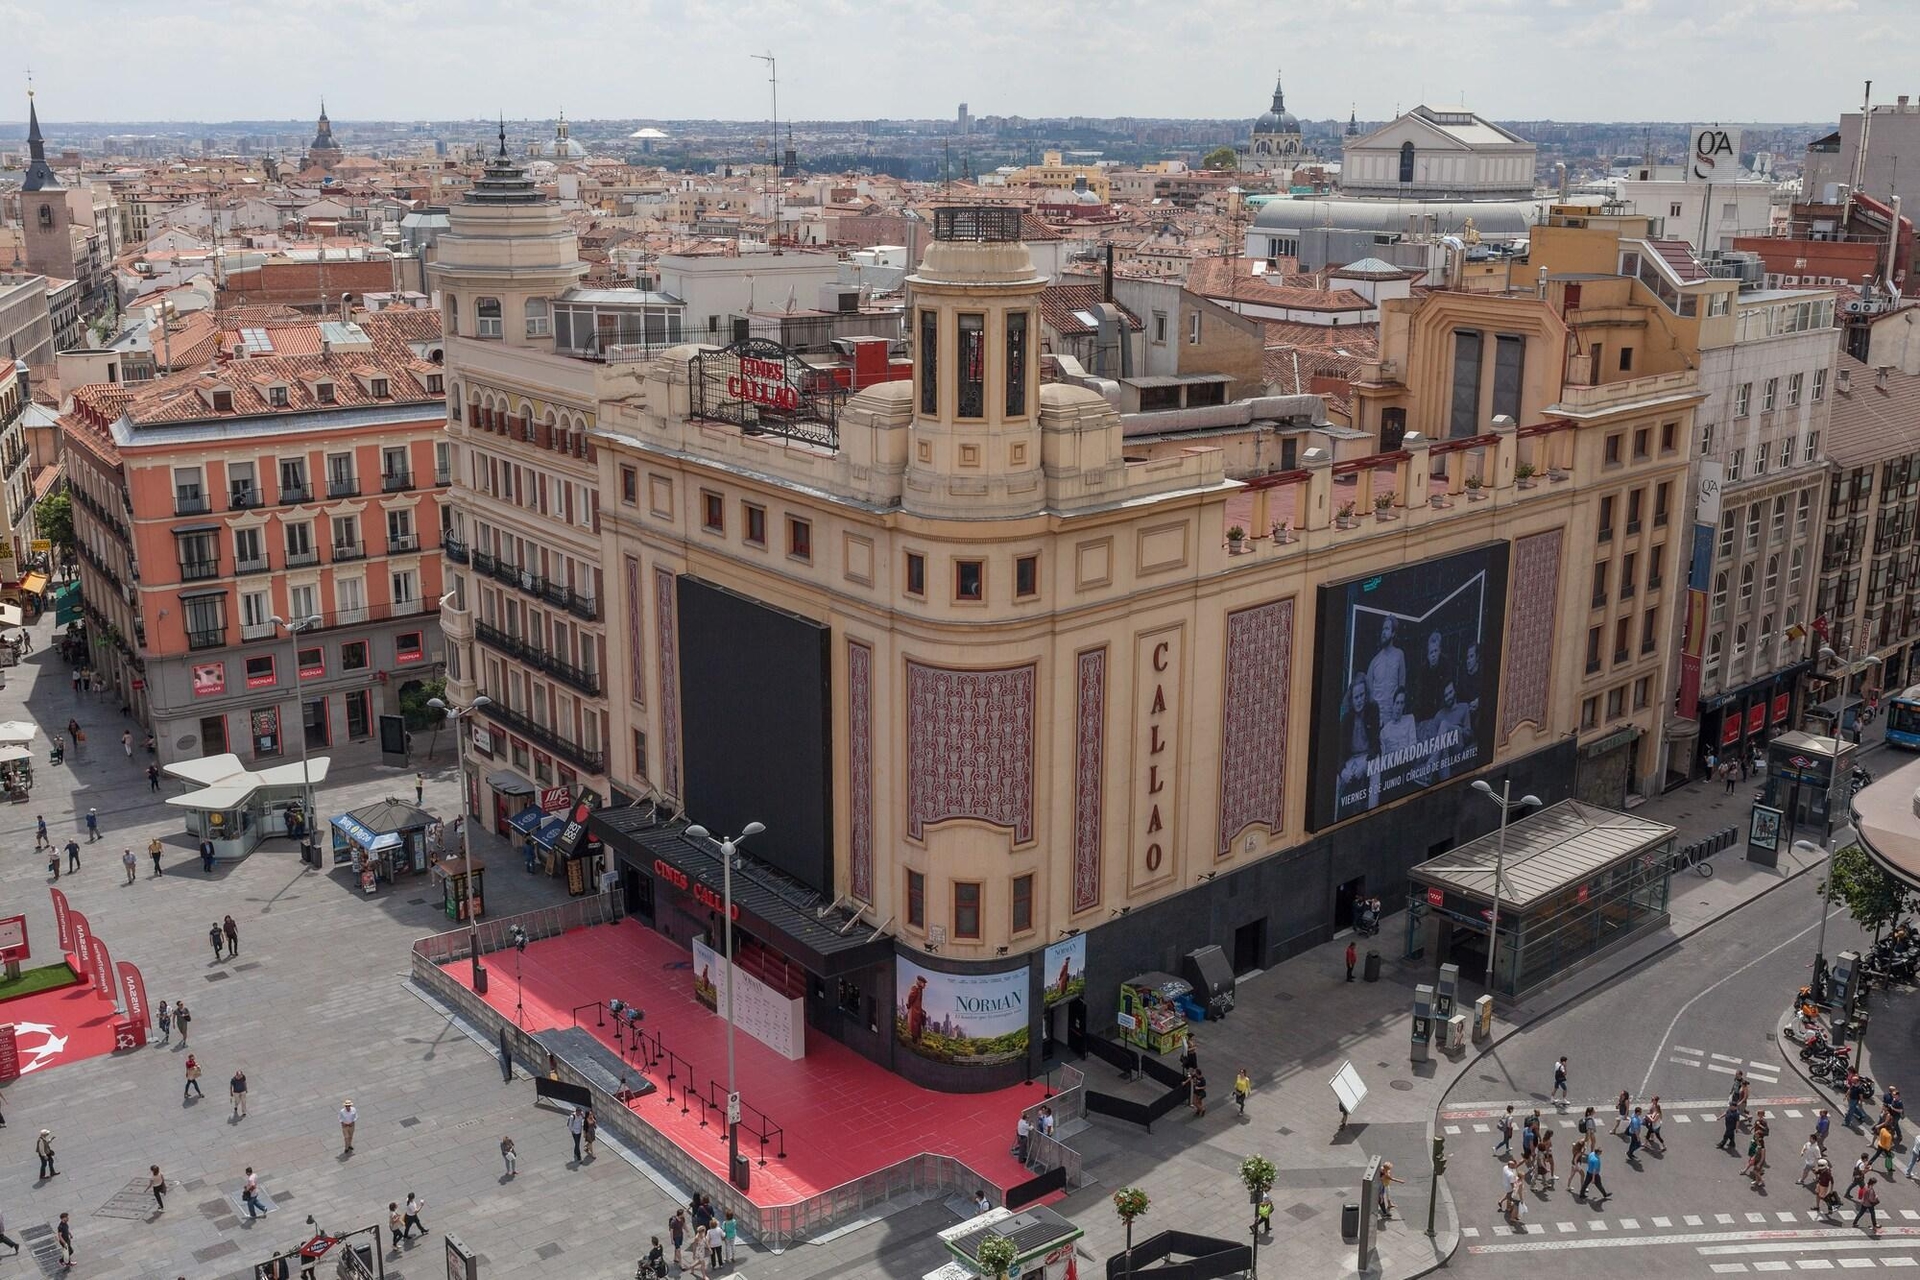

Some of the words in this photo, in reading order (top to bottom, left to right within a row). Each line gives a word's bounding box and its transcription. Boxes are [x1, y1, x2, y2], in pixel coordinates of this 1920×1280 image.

[740, 357, 783, 381] CINES
[728, 376, 798, 411] CALLAO
[1146, 641, 1168, 871] CALLAO
[1367, 729, 1459, 777] KAKKMADDAFAKKA
[1341, 788, 1367, 807] VIERNES
[1383, 775, 1402, 791] JUNIO
[1431, 760, 1440, 772] DE
[1440, 752, 1461, 769] BELLAS
[563, 828, 577, 840] DOG
[569, 820, 582, 834] HOT
[654, 859, 689, 891] CINES
[693, 883, 740, 921] CALLO
[954, 989, 1022, 1013] NORMAN
[310, 1242, 327, 1251] Metro
